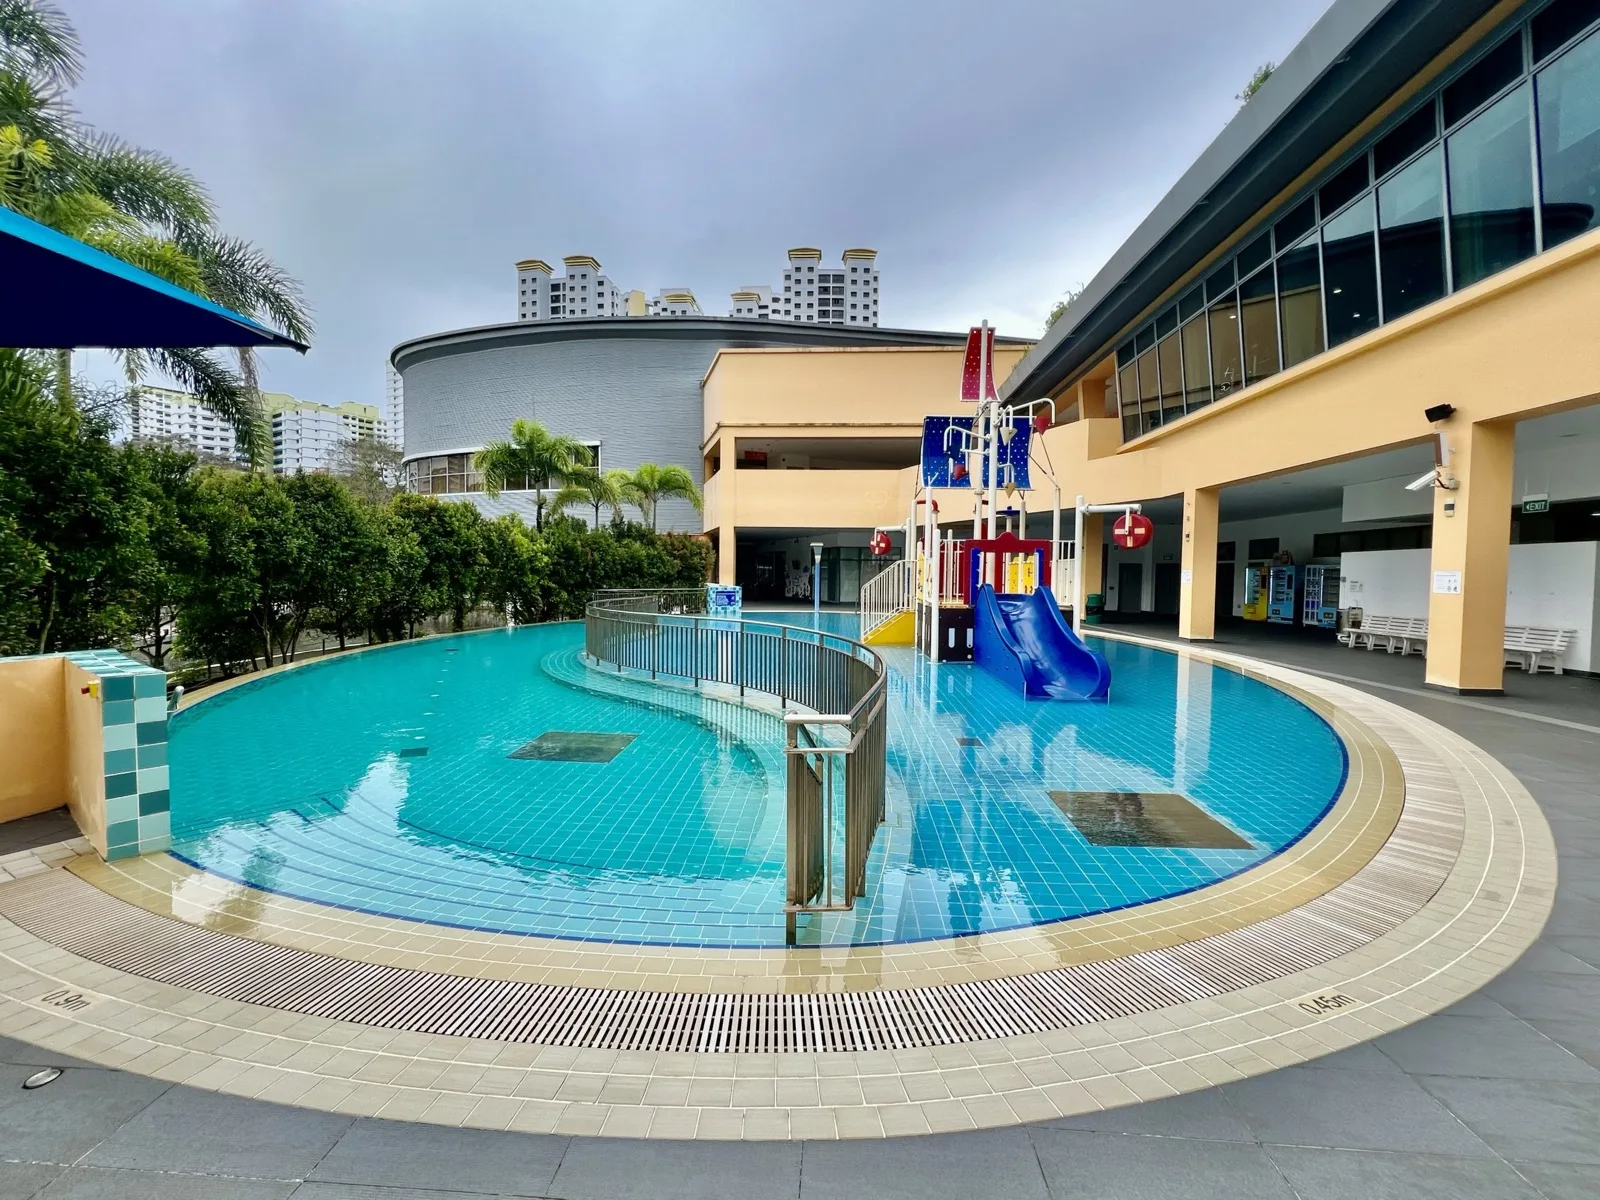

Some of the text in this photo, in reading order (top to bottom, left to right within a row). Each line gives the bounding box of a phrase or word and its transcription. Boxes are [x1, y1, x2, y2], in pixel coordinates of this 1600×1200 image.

[1530, 501, 1546, 511] EXIT
[41, 990, 91, 1011] 0.9m
[1298, 994, 1356, 1015] 0.45m
